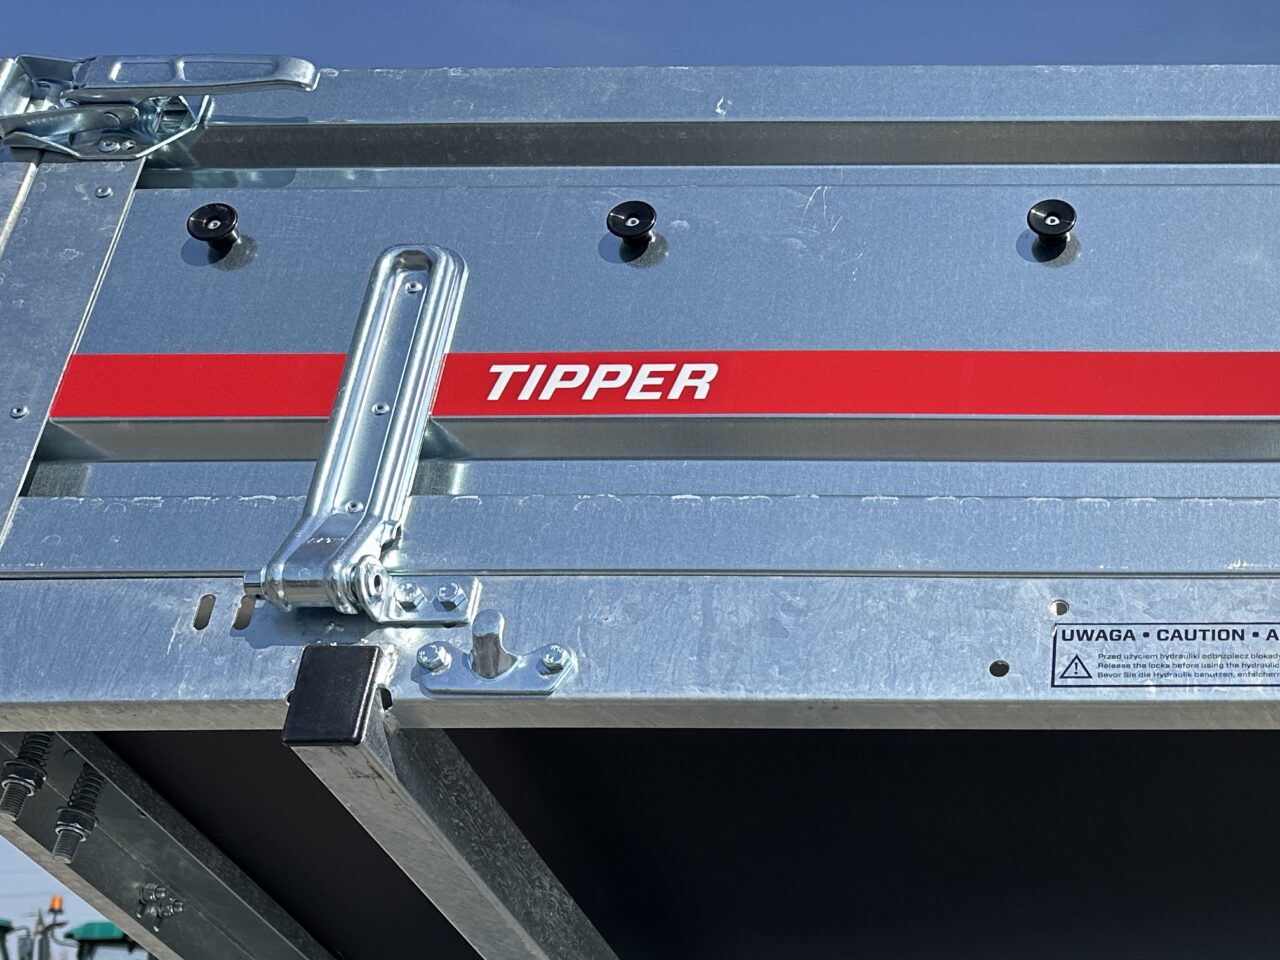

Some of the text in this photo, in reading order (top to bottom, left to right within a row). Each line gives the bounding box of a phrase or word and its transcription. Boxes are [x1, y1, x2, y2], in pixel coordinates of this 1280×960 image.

[486, 363, 719, 401] TIPPER
[1061, 629, 1136, 642] UWAGA
[1156, 629, 1245, 641] CAUTION
[1201, 662, 1224, 670] using
[1241, 662, 1280, 670] hydraulic
[1153, 671, 1192, 679] Hydraulik
